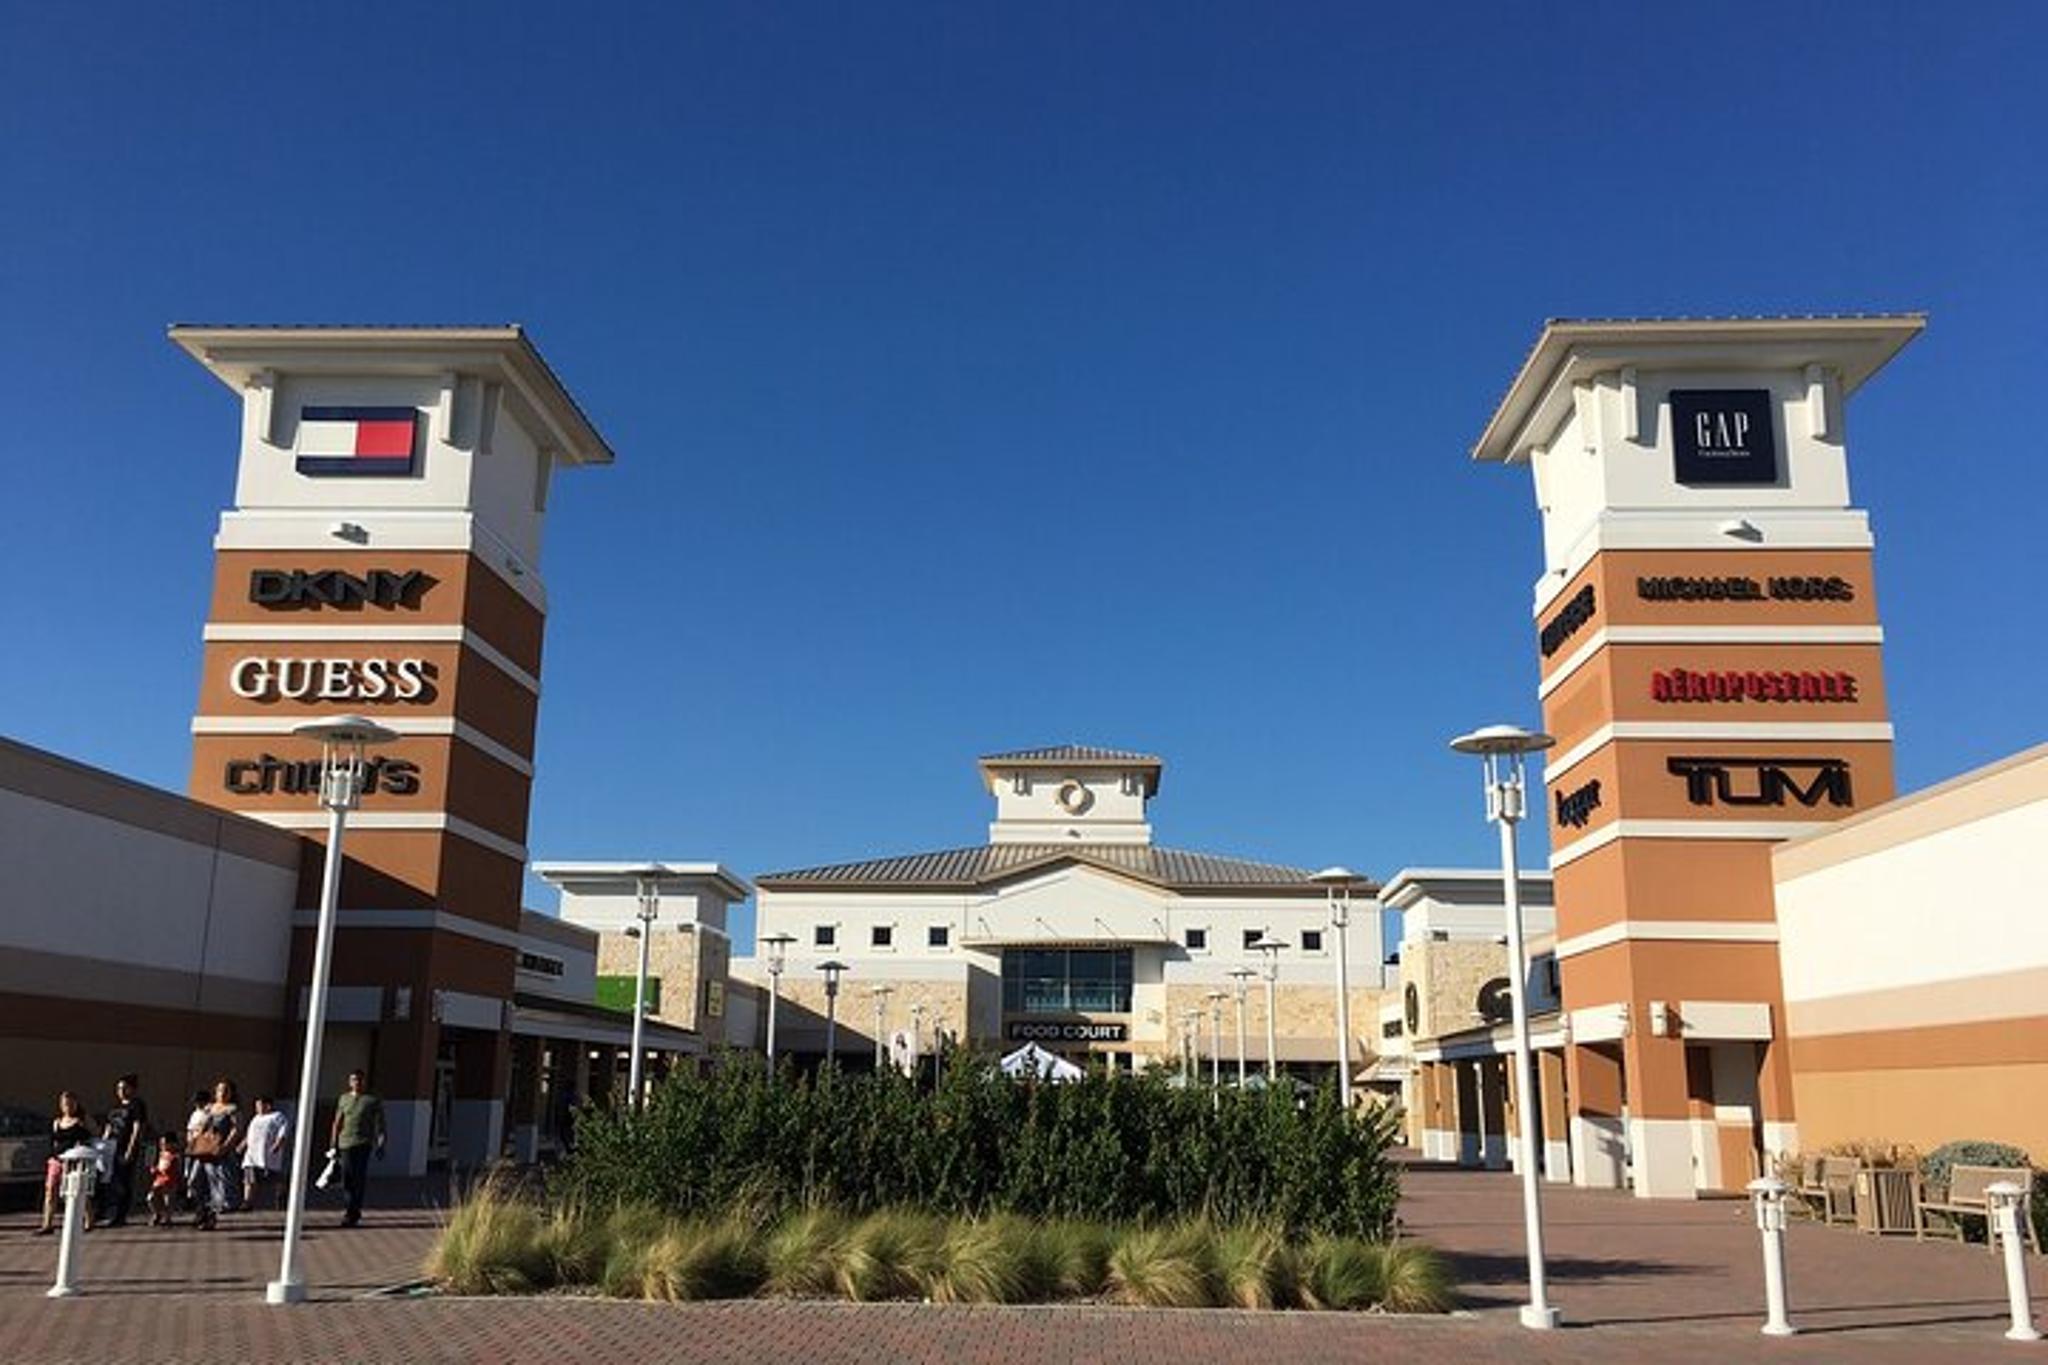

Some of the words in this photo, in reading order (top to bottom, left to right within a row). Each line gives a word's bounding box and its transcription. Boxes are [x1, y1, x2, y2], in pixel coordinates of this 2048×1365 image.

[1697, 411, 1748, 448] GAP
[250, 569, 427, 606] DKNY
[1637, 577, 1762, 600] MICHAEL
[1767, 577, 1852, 601] KORS
[229, 656, 424, 698] GUESS
[1011, 1024, 1059, 1039] FOOD
[1062, 1024, 1122, 1039] COURT
